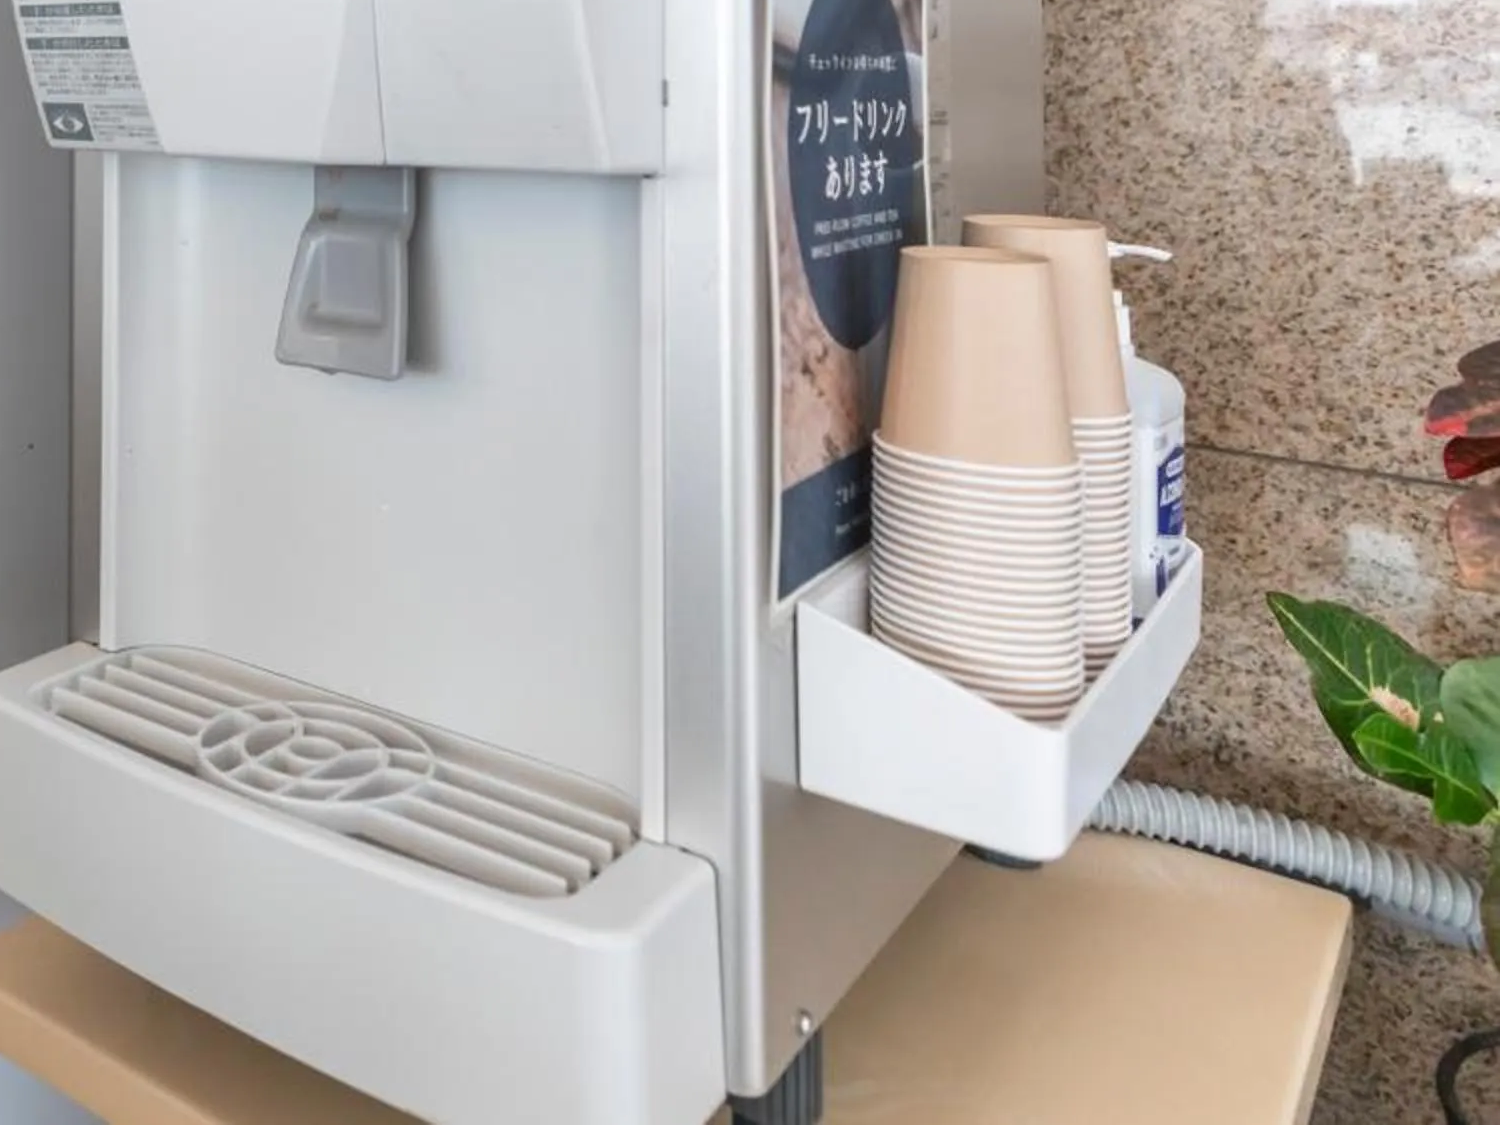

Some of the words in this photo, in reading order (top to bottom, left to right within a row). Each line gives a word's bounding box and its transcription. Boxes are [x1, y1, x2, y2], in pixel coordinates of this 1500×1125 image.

[796, 99, 907, 144] フリードリンク
[826, 150, 888, 201] あります
